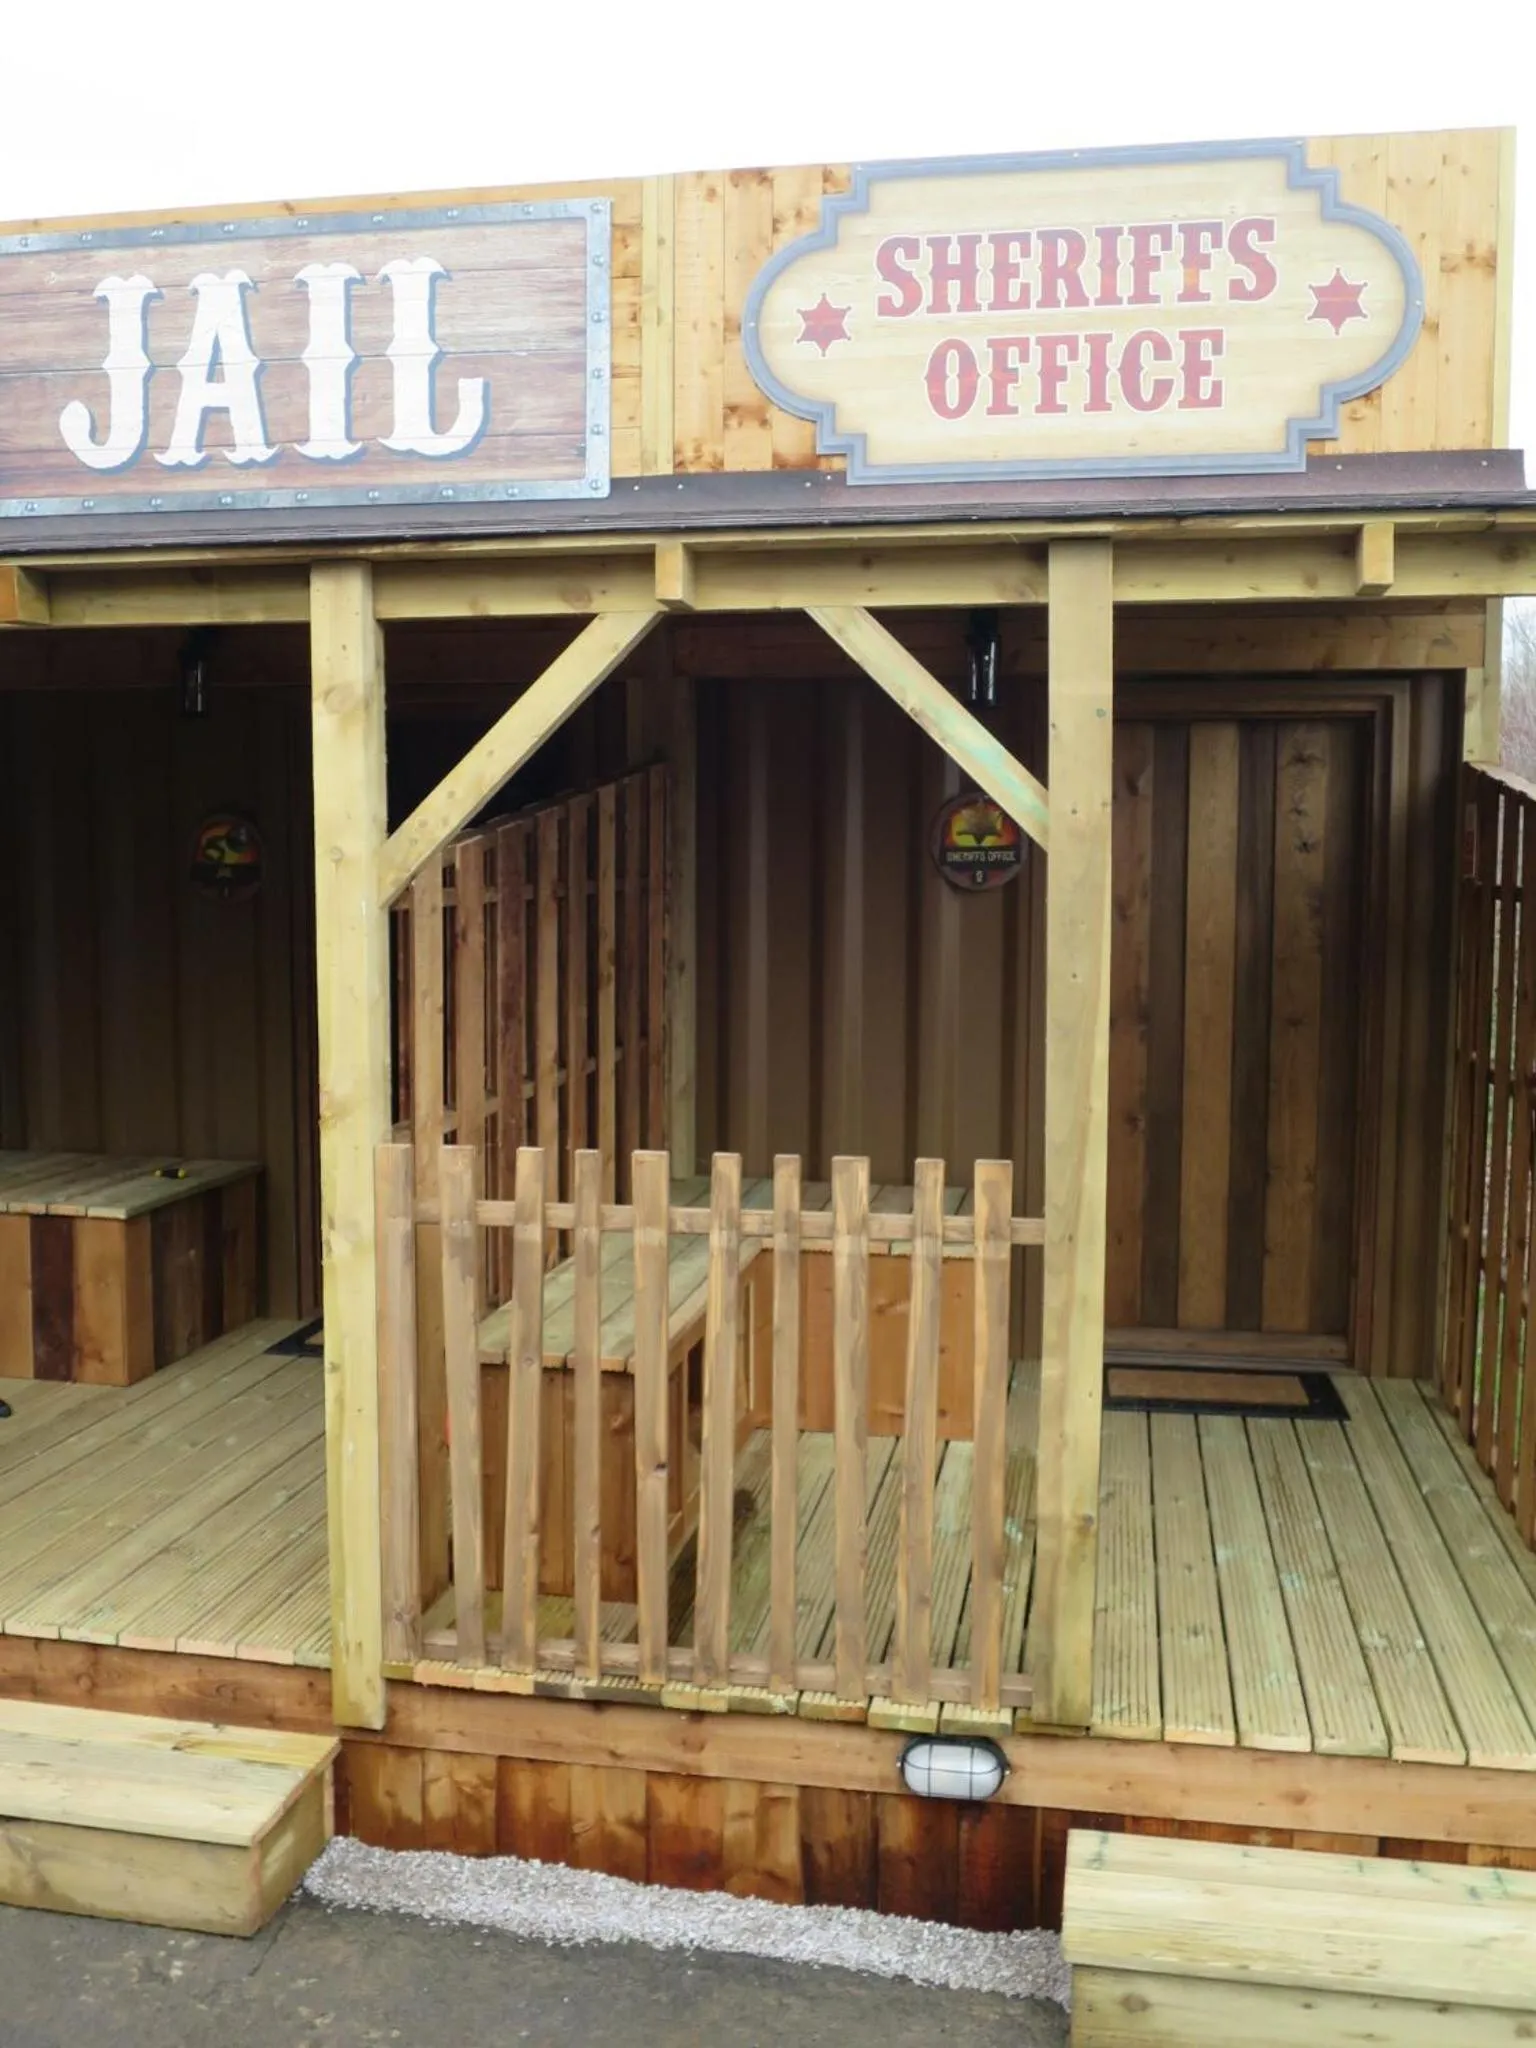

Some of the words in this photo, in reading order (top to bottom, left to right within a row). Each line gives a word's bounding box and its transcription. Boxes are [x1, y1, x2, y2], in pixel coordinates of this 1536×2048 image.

[876, 217, 1278, 318] SHERIFFS
[58, 256, 491, 474] JAIL
[923, 328, 1226, 420] OFFICE
